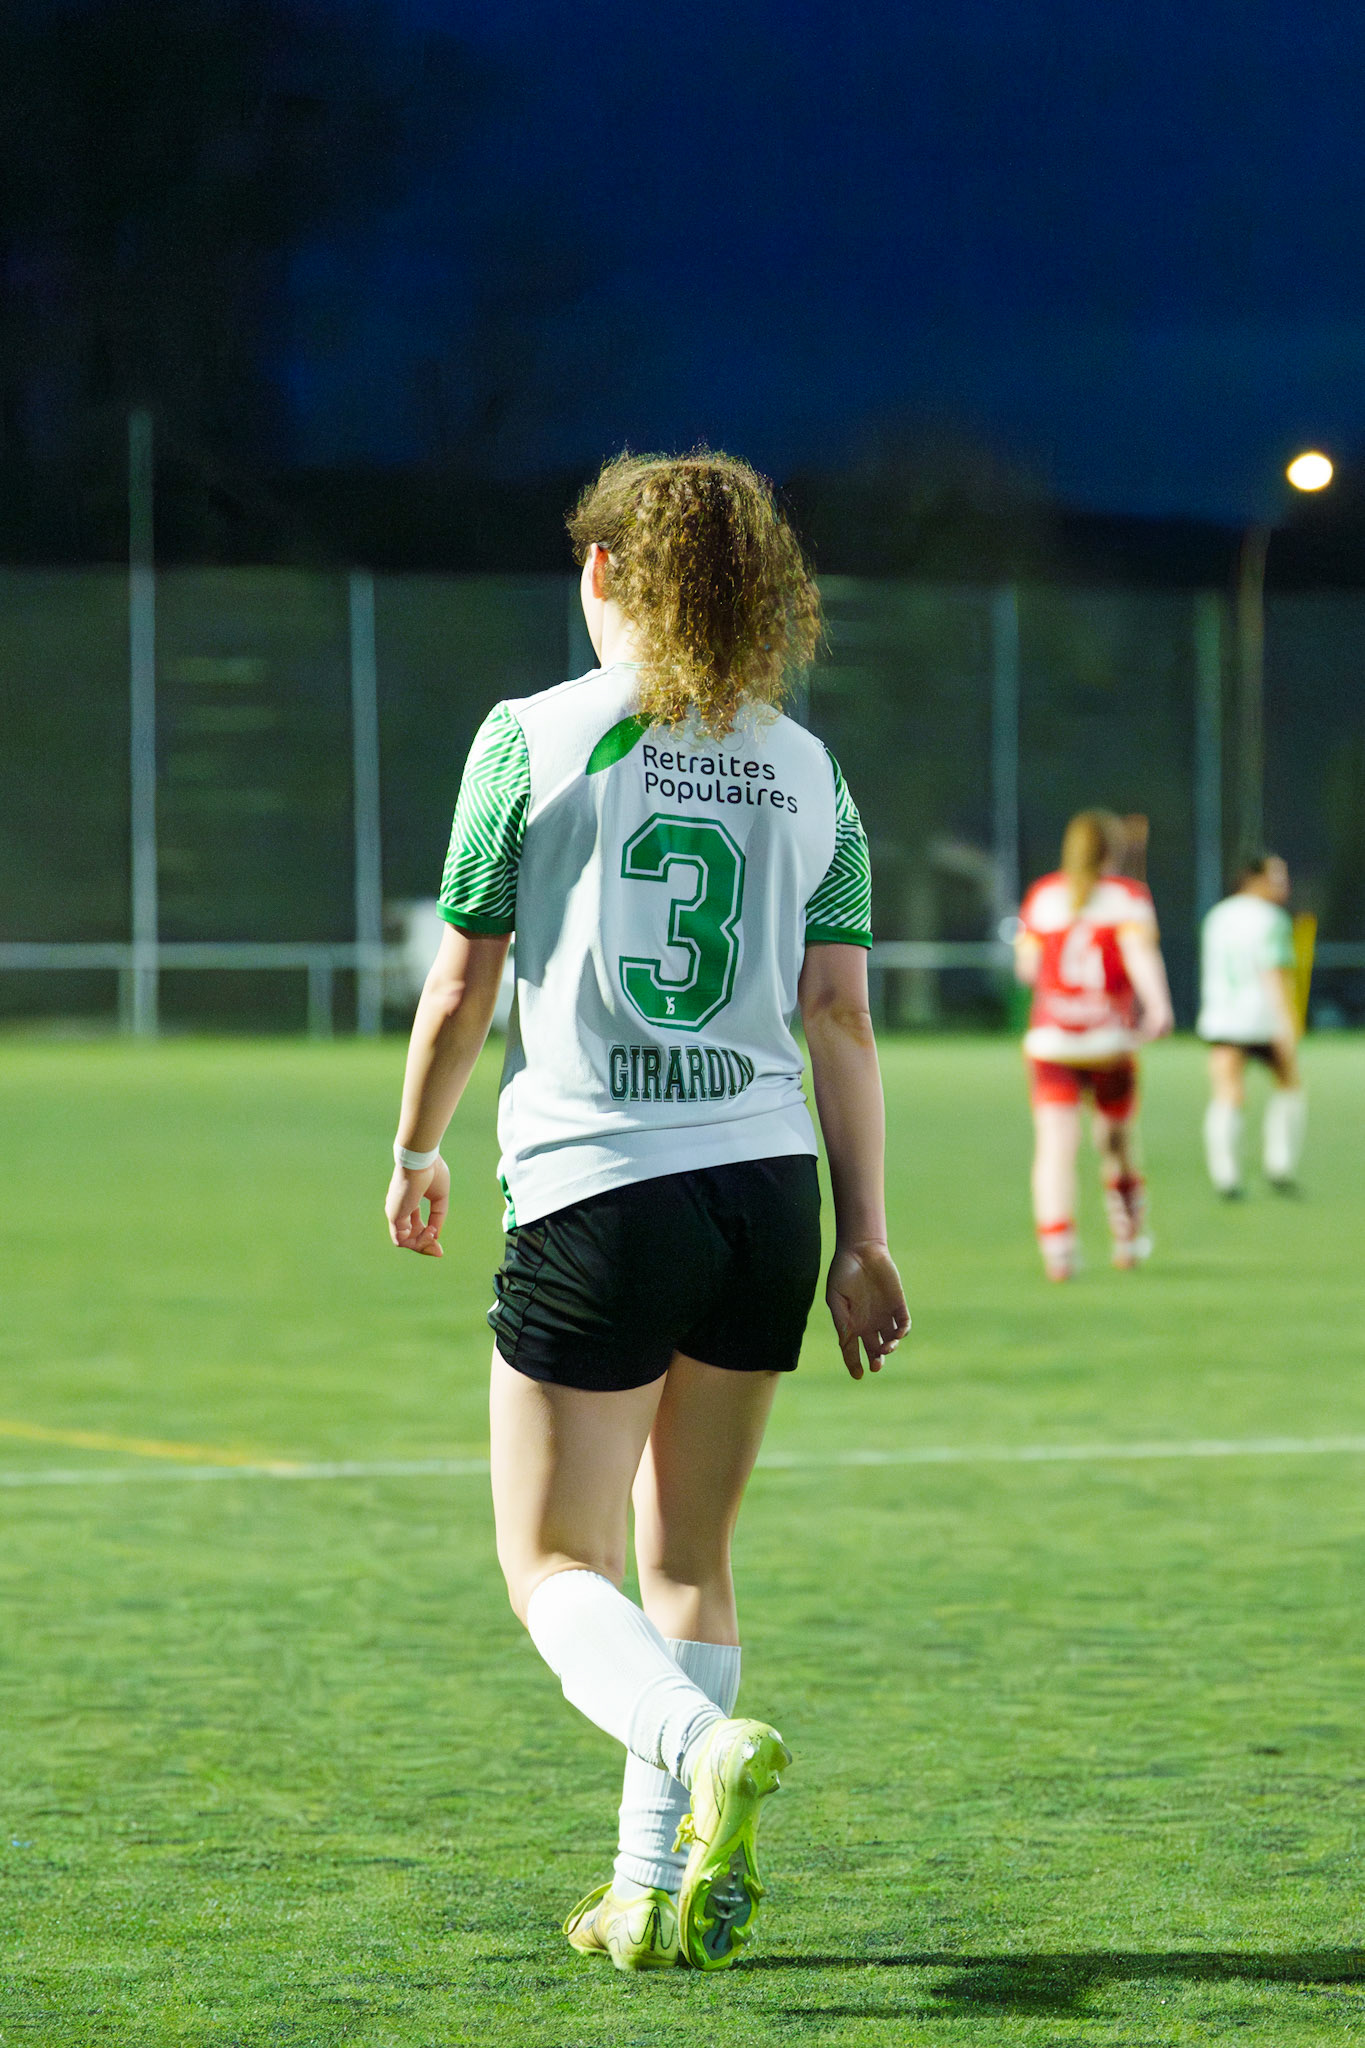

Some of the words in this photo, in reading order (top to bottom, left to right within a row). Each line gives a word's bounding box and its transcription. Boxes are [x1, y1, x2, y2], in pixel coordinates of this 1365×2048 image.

[643, 745, 775, 780] Retraites
[645, 772, 798, 813] Populaires
[620, 812, 746, 1031] 3
[610, 1045, 755, 1102] GIRARDIN
